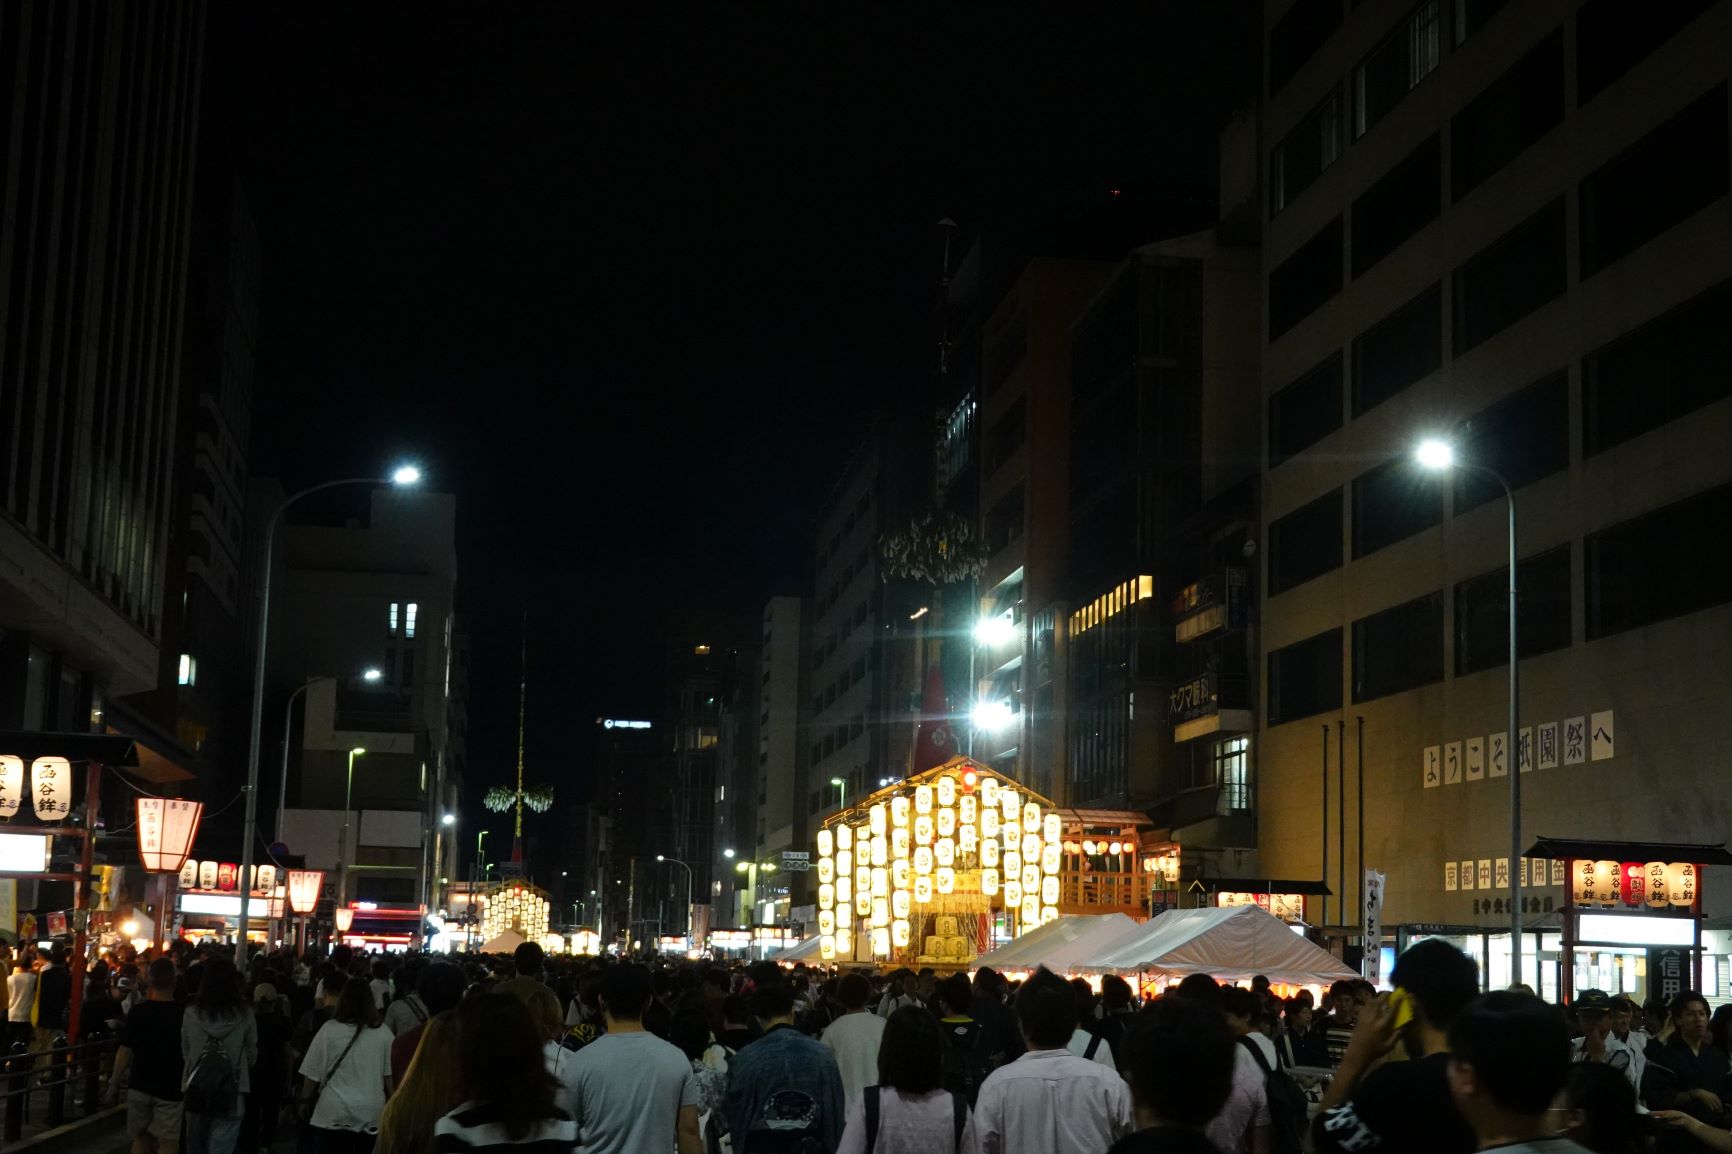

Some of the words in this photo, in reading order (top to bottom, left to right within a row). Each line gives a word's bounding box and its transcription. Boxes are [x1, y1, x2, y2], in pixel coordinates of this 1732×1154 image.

[1427, 723, 1611, 782] ようこそ祇園祭へ
[1583, 863, 1595, 899] 函谷鉾
[1651, 865, 1664, 901] 函谷鉾
[1658, 950, 1681, 999] 信用
